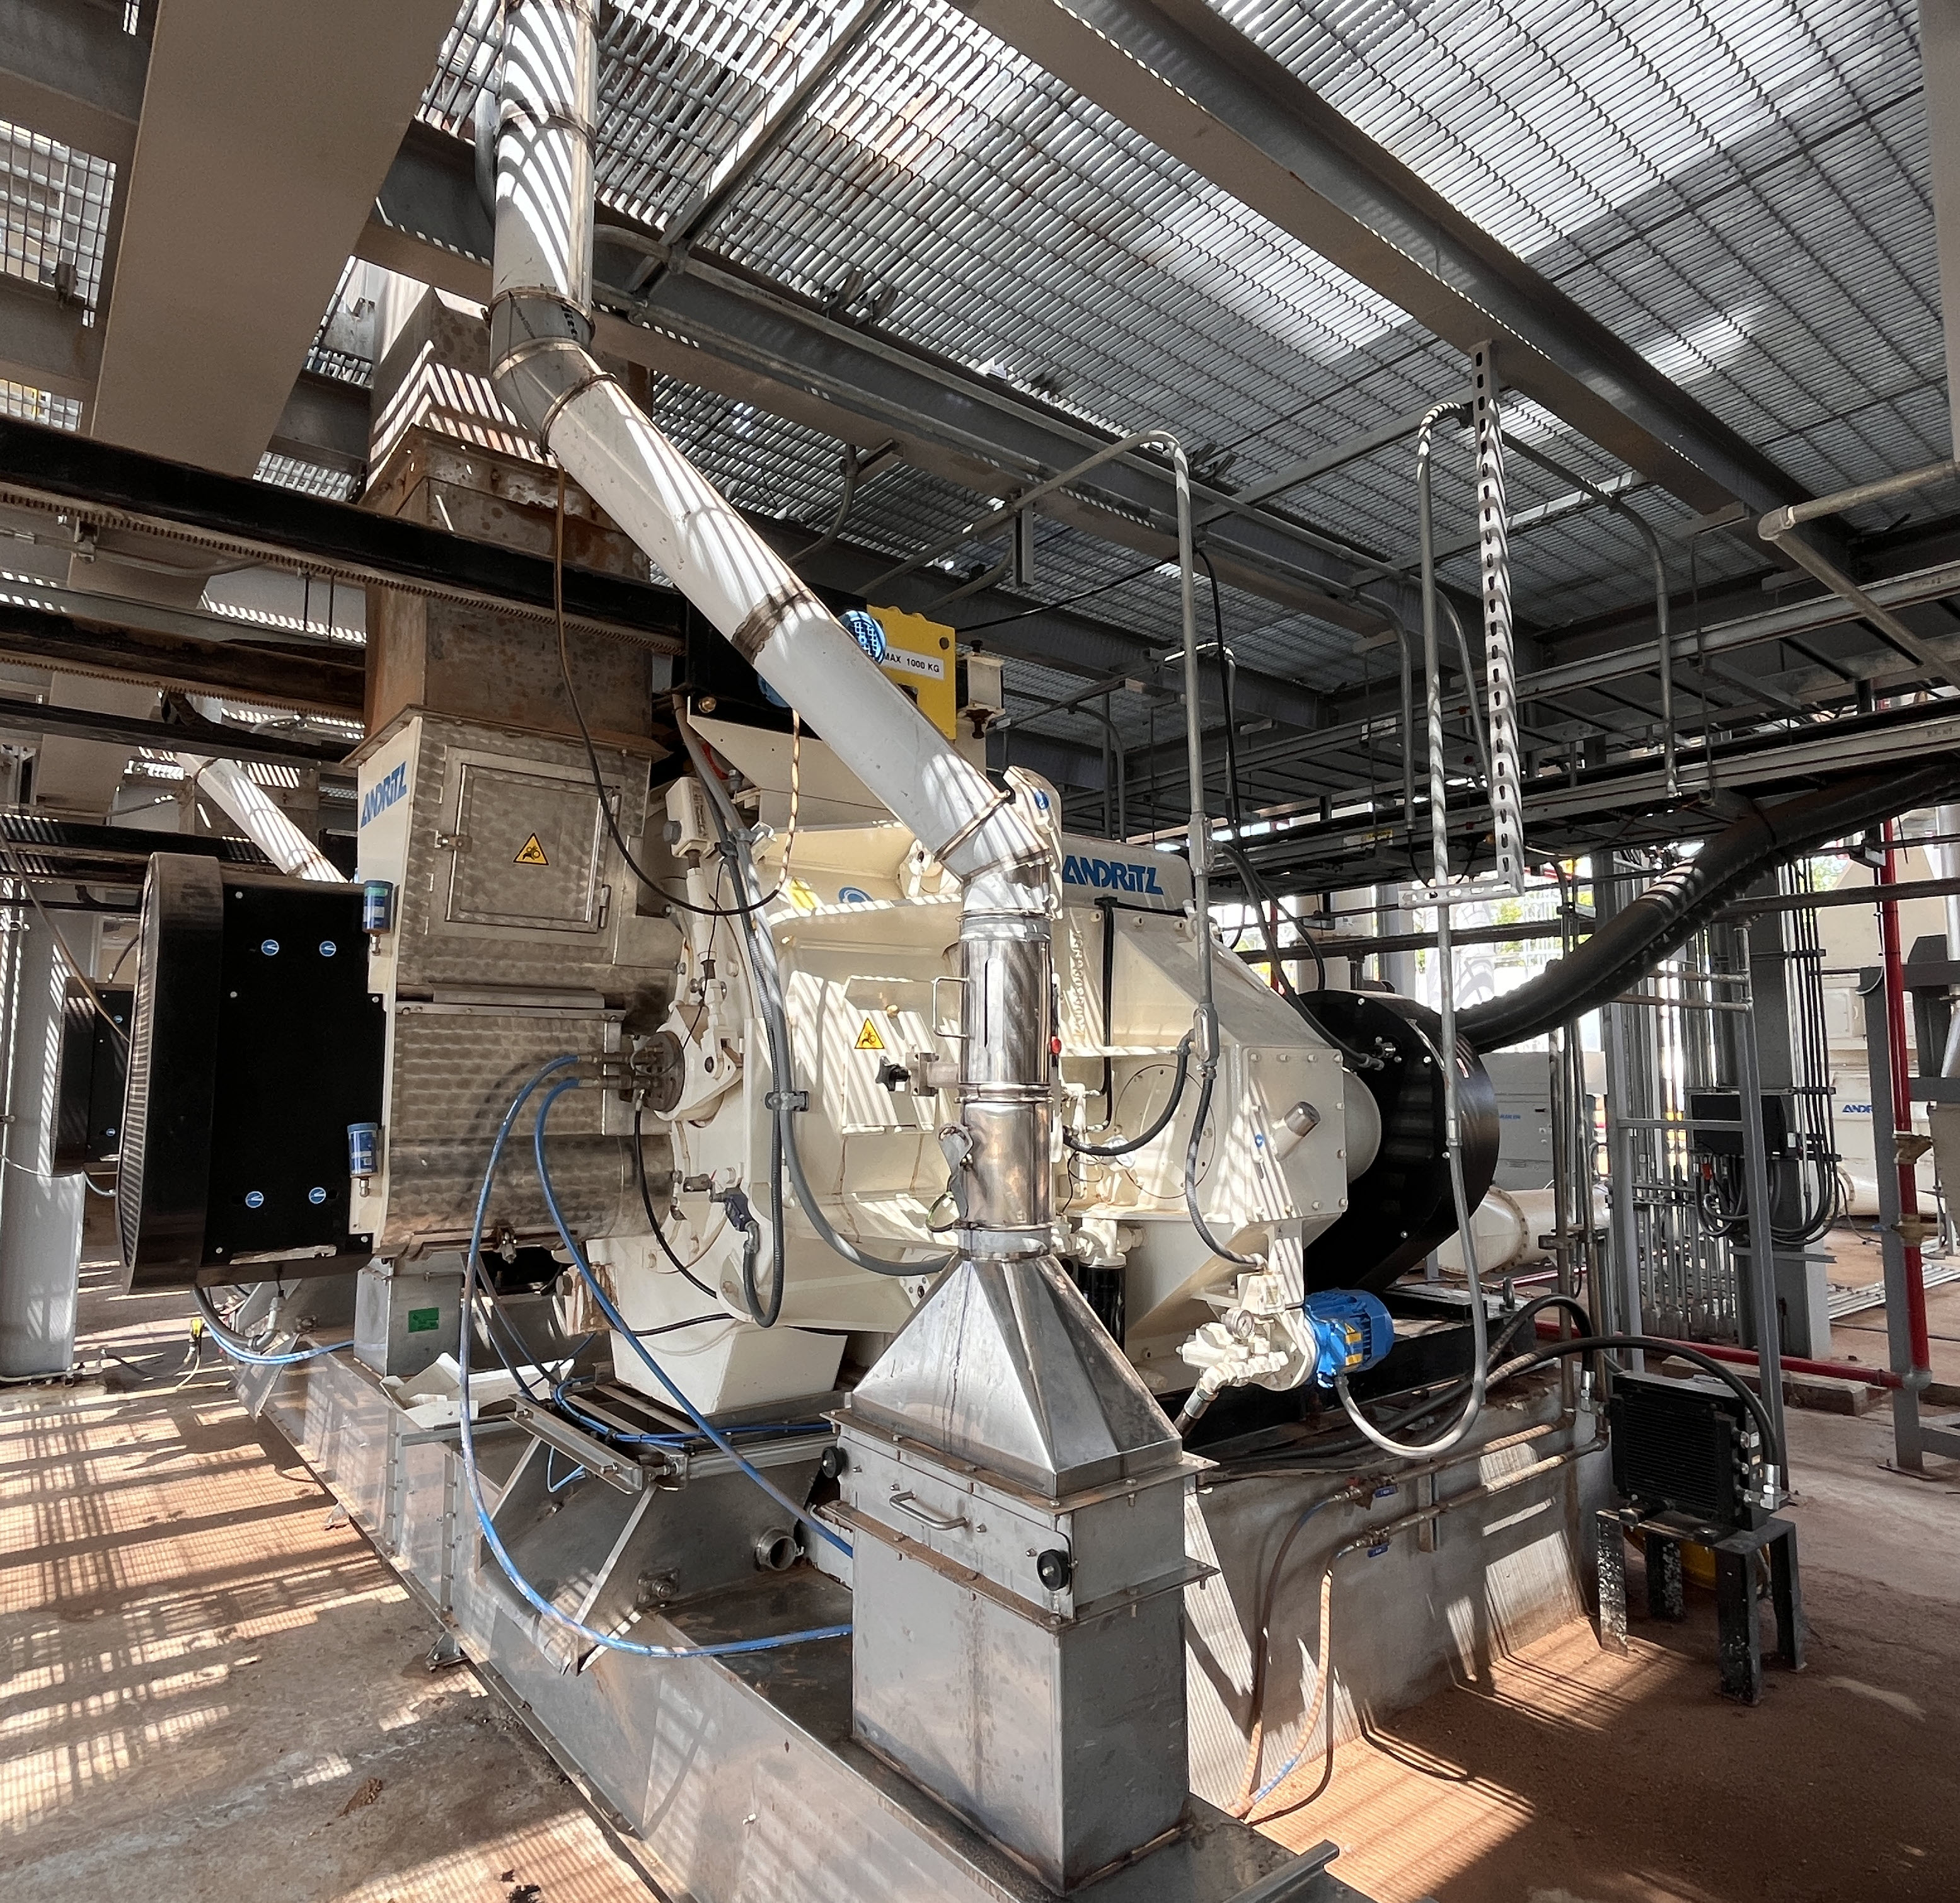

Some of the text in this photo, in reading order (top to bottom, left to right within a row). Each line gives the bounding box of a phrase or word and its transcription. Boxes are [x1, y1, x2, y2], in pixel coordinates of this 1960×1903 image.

[907, 658, 925, 669] 1000
[928, 663, 940, 672] KG
[360, 761, 406, 829] ANDRITZ
[1062, 855, 1164, 895] ANDRITZ
